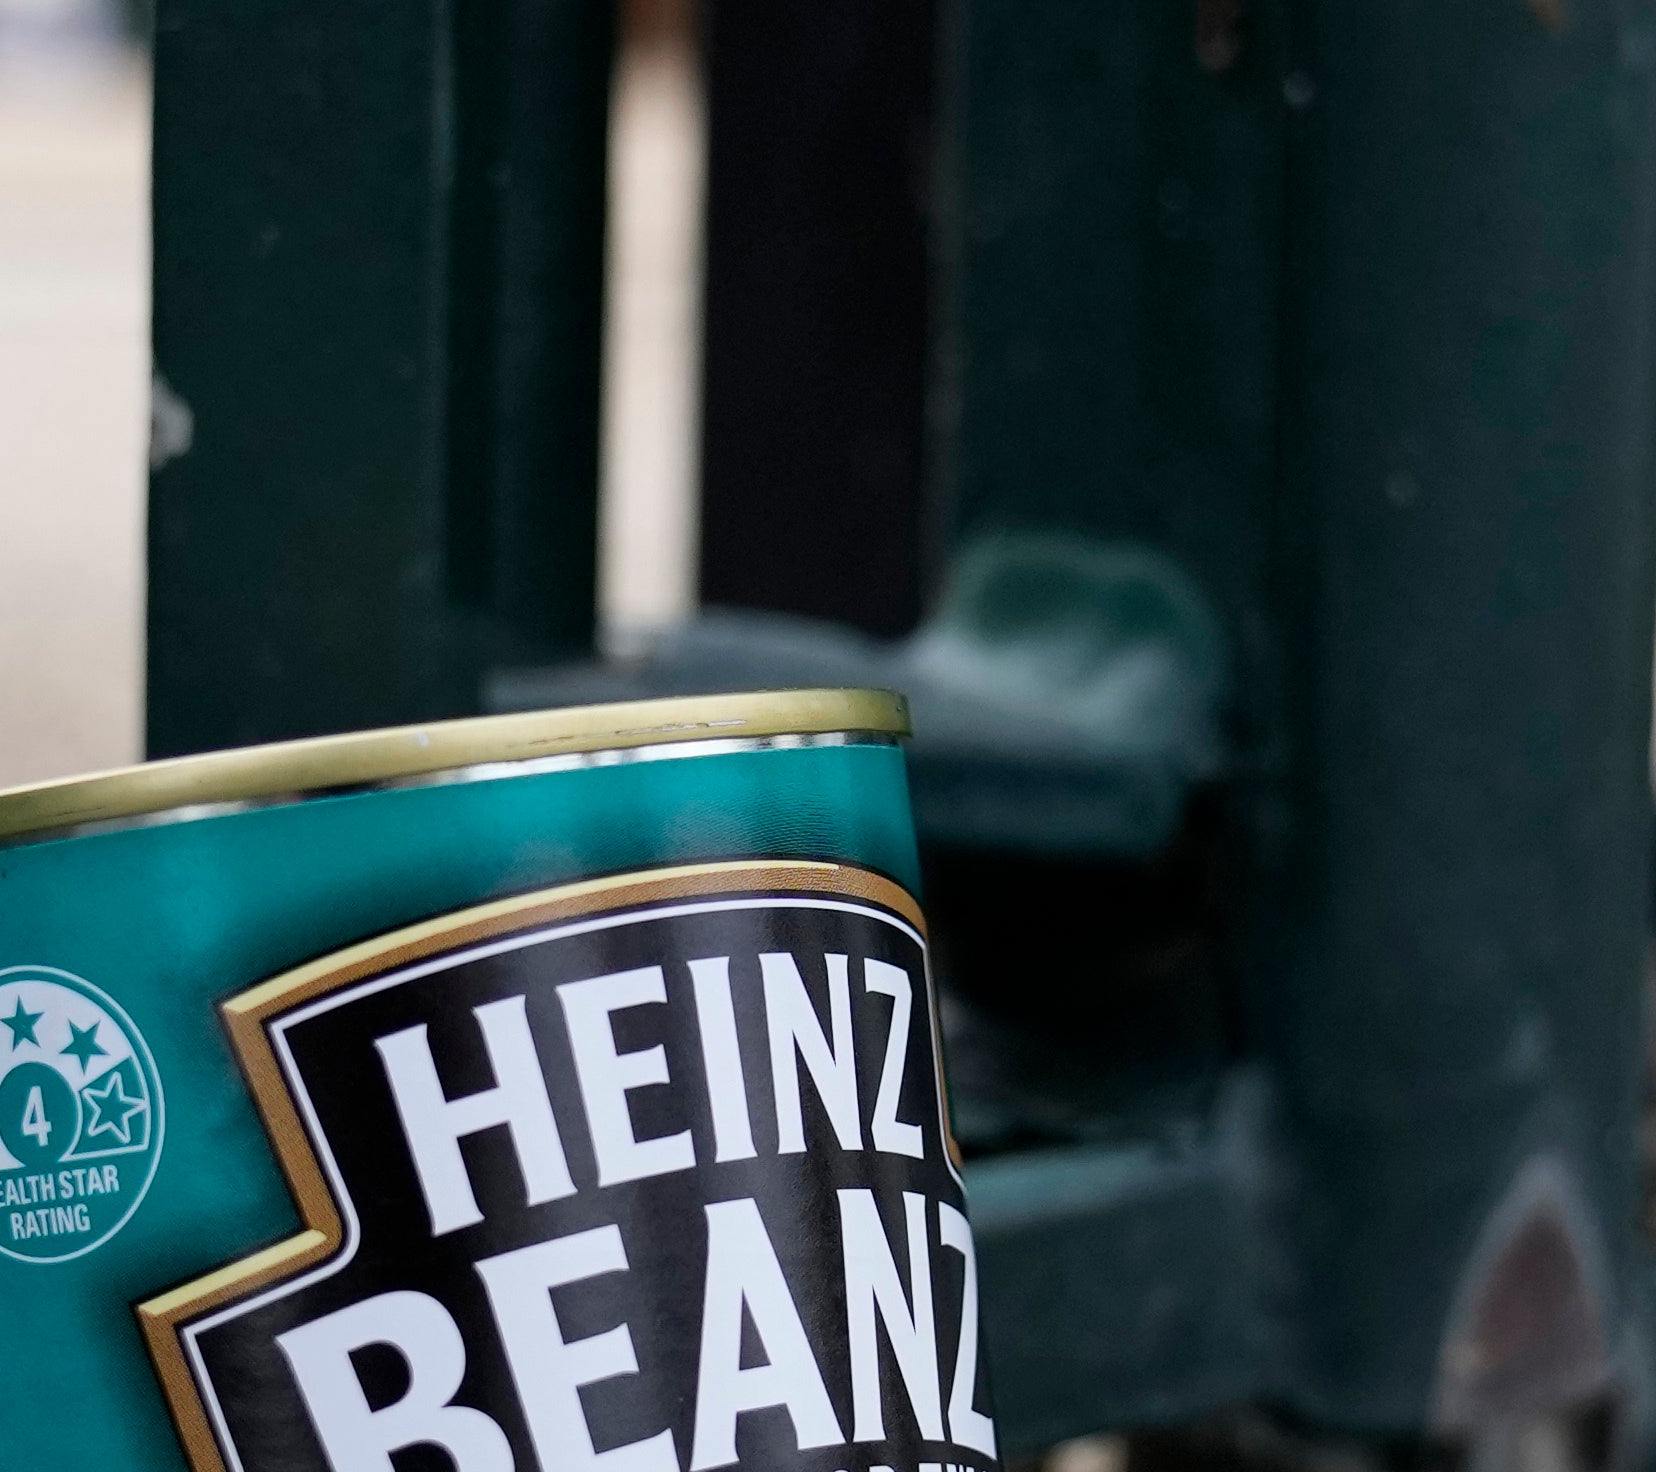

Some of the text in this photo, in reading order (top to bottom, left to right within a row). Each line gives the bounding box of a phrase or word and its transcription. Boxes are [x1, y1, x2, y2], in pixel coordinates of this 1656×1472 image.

[21, 1084, 53, 1147] 4
[374, 952, 924, 1237] HEINZ
[59, 1163, 120, 1201] STAR
[9, 1203, 91, 1241] RATING
